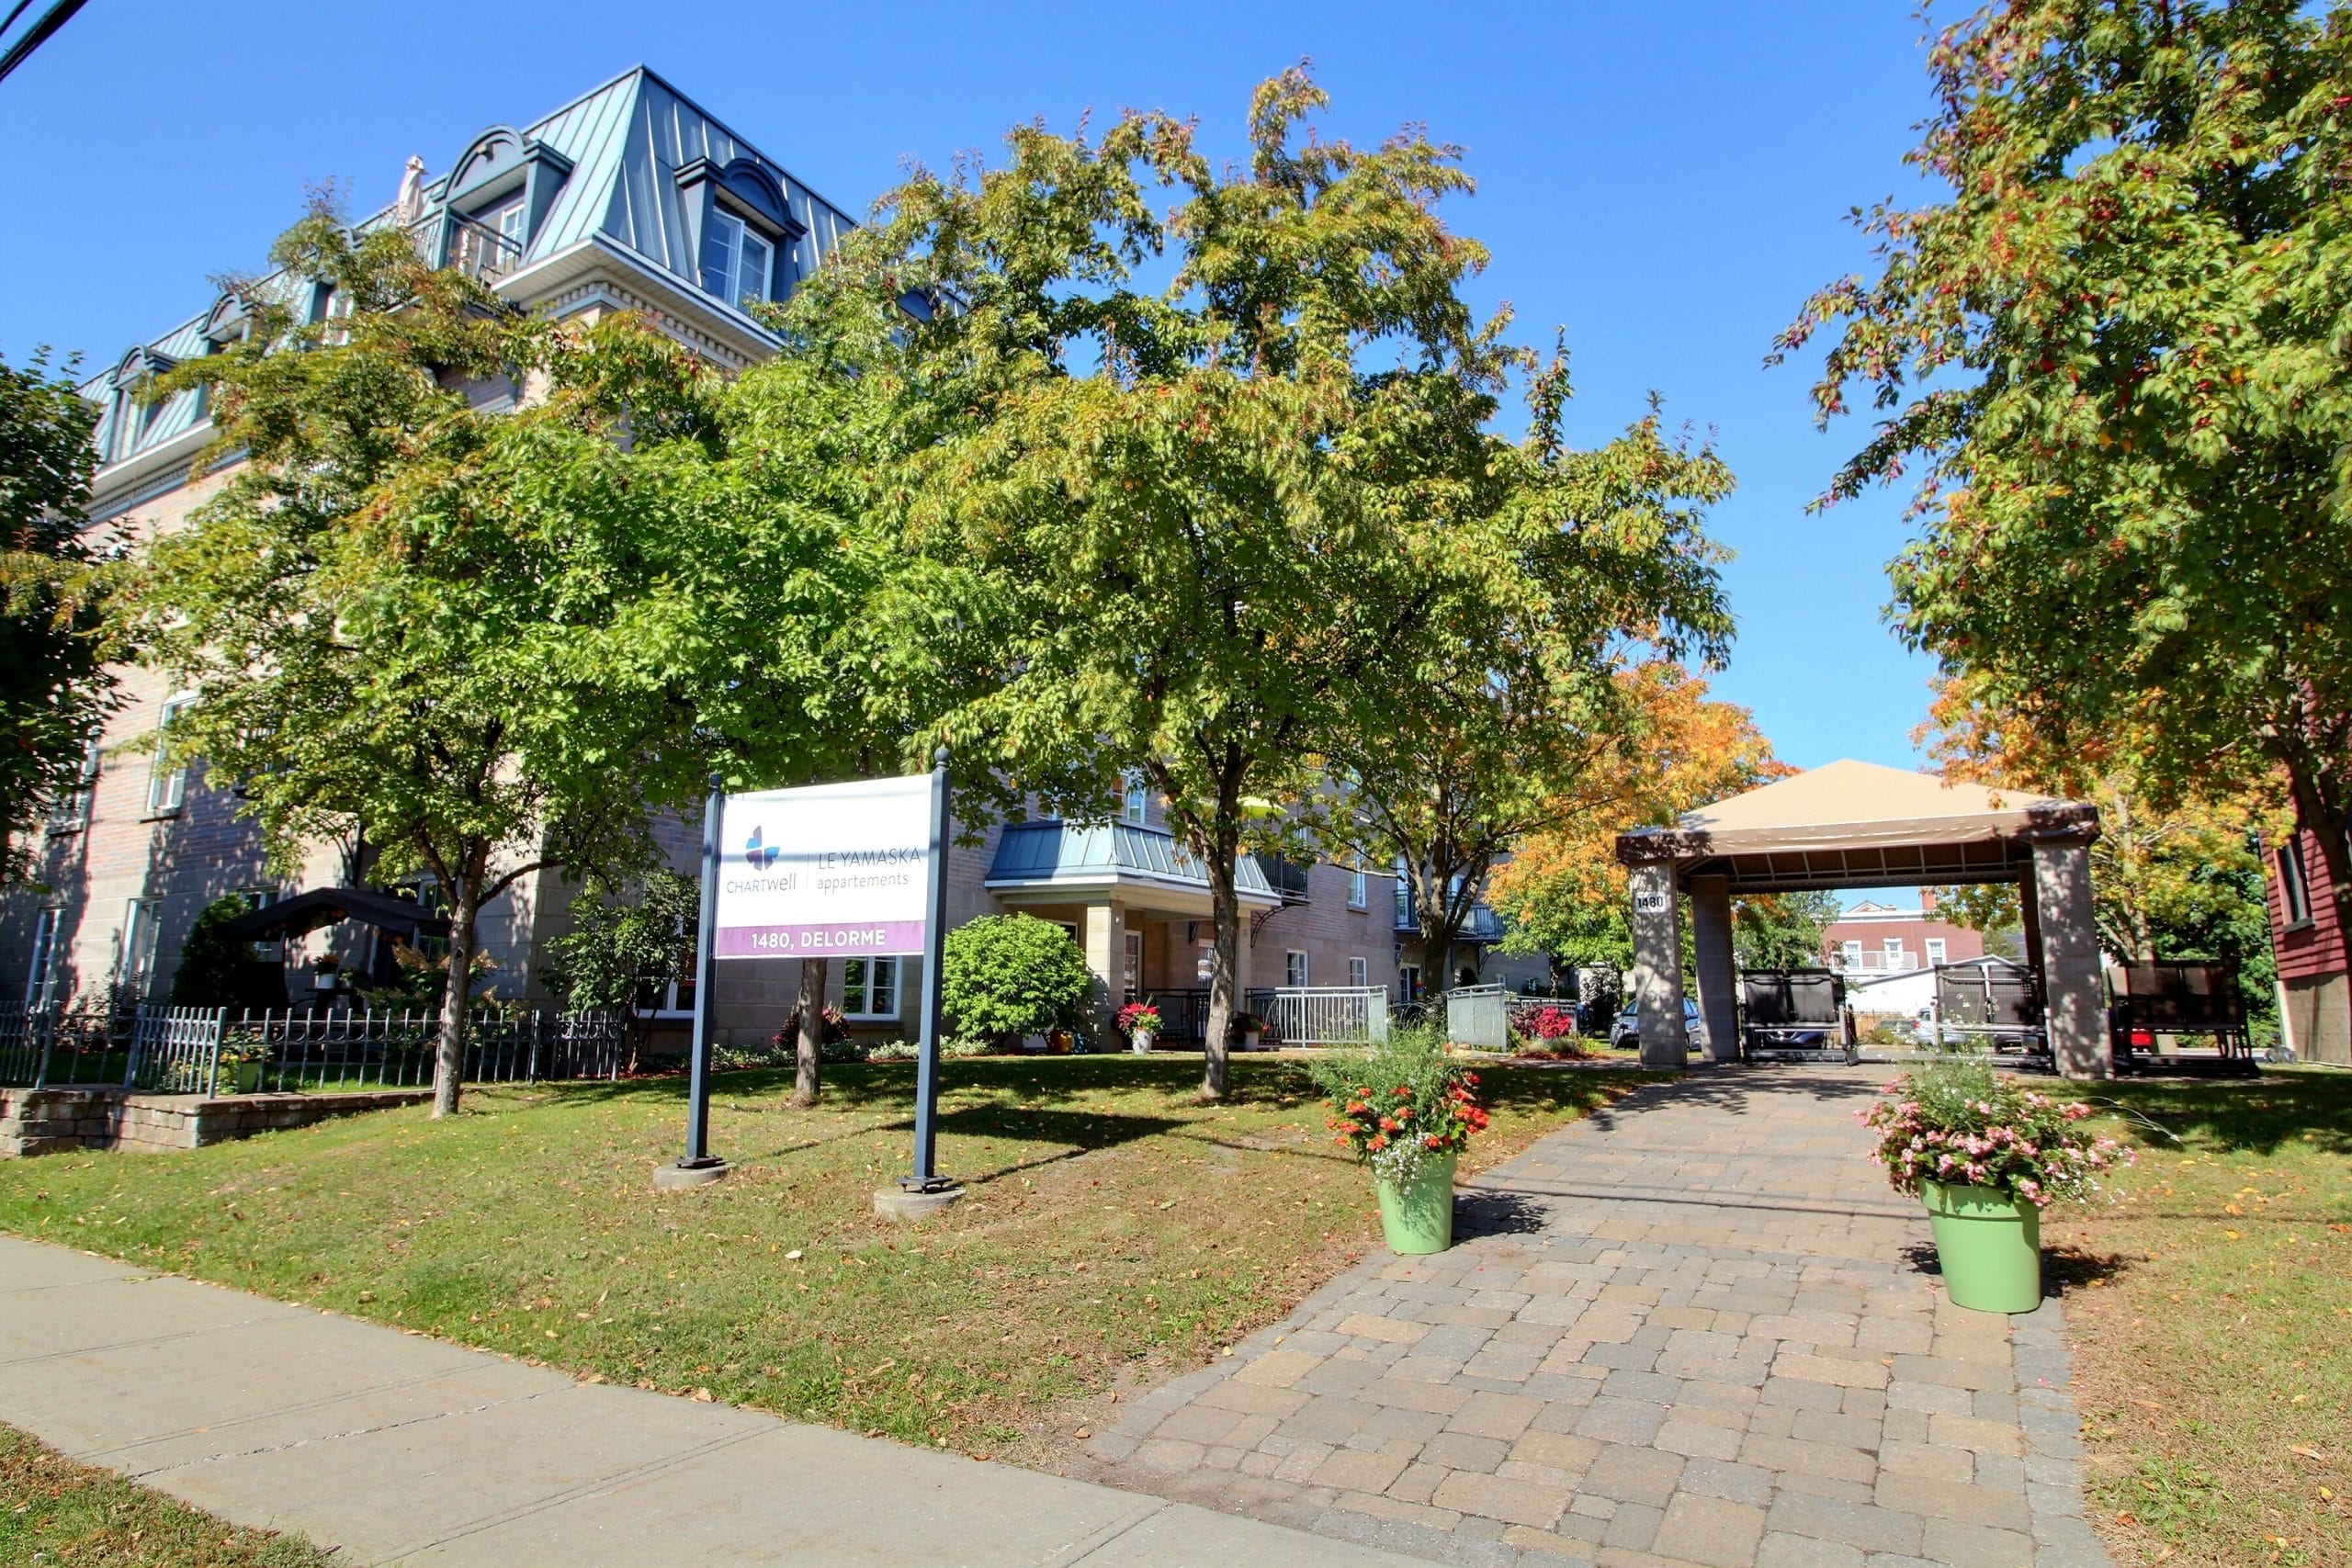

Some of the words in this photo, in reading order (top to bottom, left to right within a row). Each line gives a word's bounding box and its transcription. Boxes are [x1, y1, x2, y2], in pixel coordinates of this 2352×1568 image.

[818, 852, 836, 870] LE
[840, 847, 922, 867] YAMASKA
[817, 873, 909, 895] appartements
[1636, 896, 1664, 908] 1480
[752, 932, 795, 950] 1480,
[800, 930, 886, 947] DELORME
